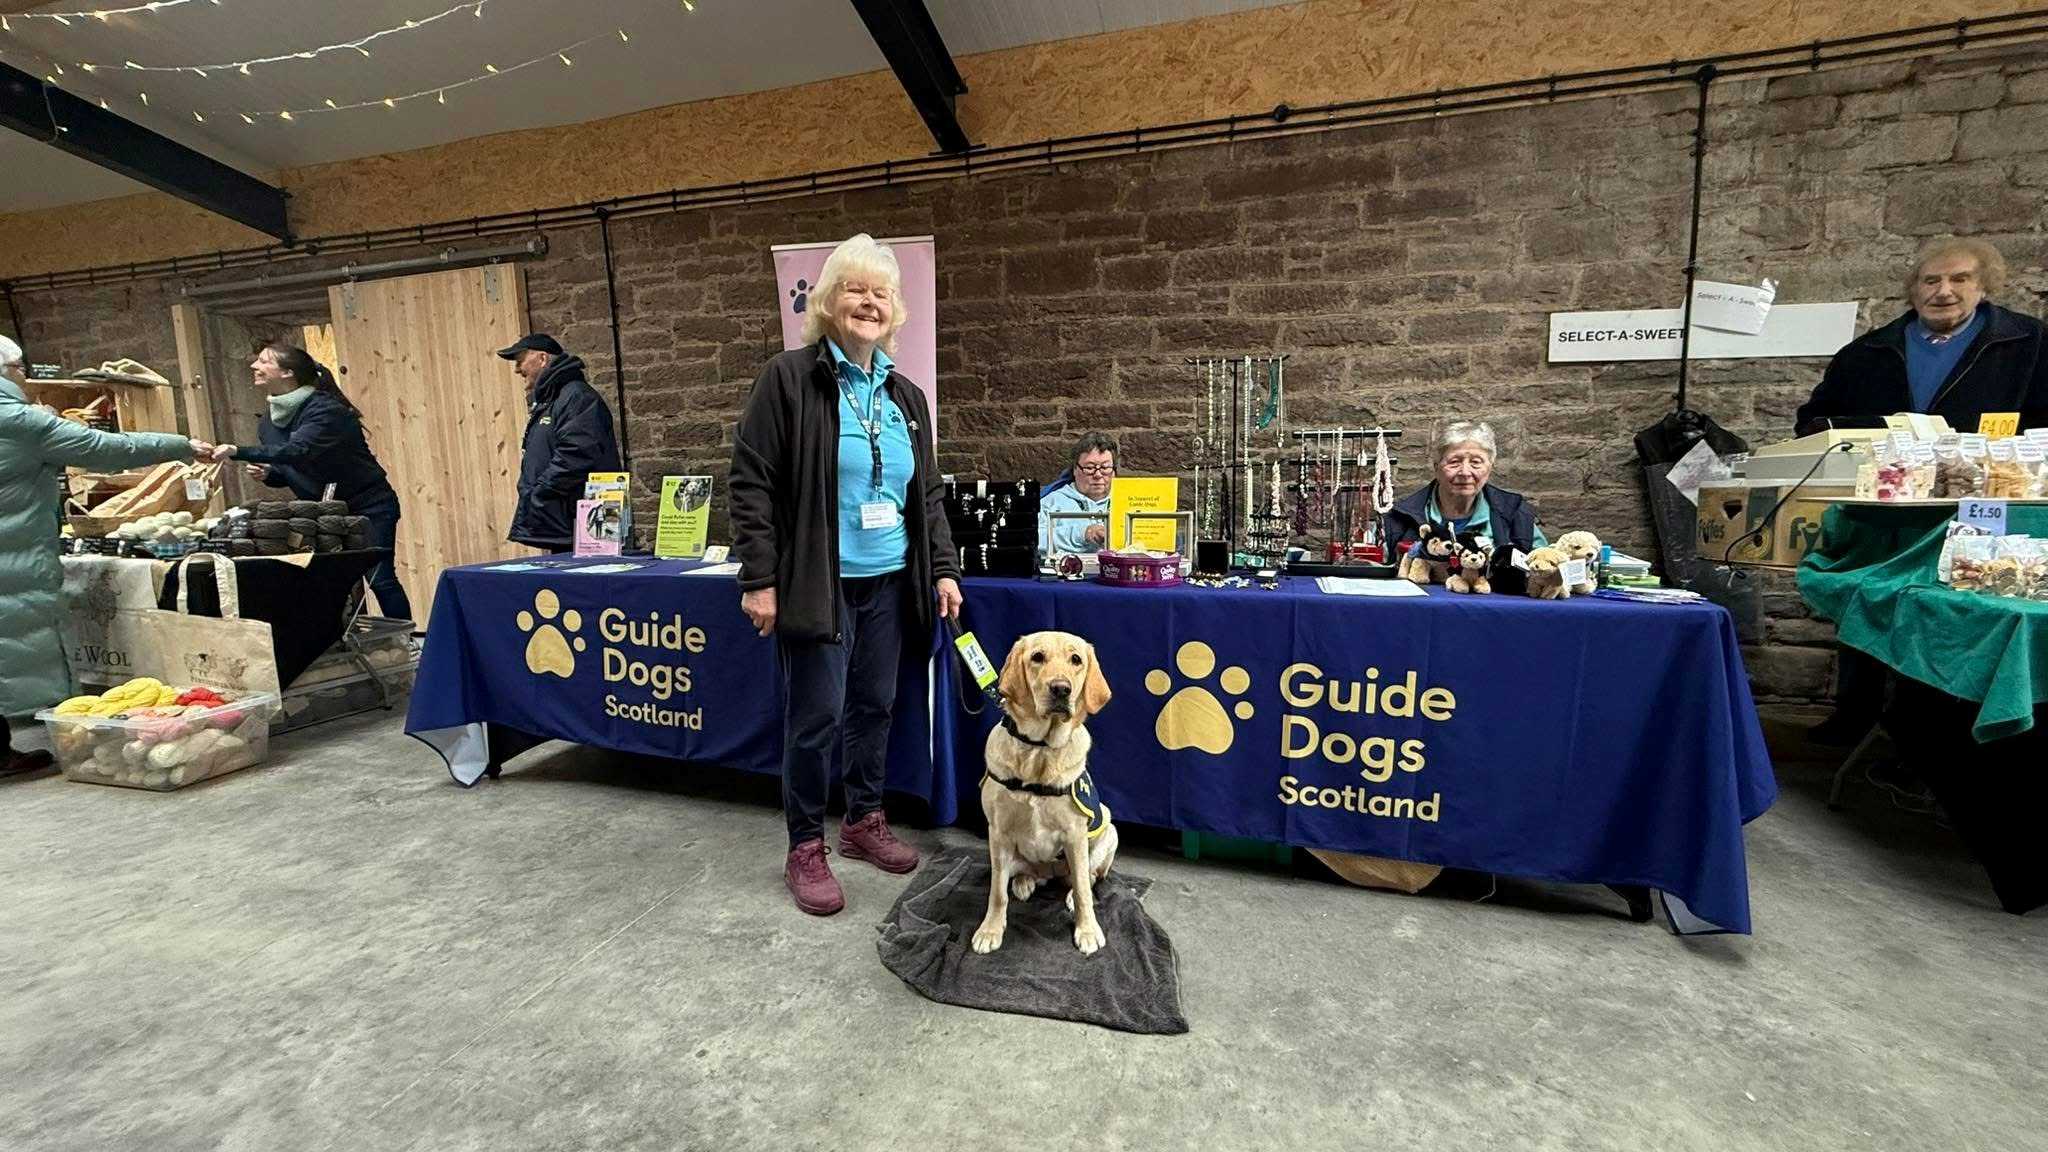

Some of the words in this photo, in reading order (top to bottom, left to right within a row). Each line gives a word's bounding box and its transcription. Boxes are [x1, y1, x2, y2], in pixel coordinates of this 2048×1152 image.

[1558, 328, 1685, 343] SELECT-A-SWEET
[1969, 503, 2001, 518] £1.50
[599, 607, 706, 653] Guide
[603, 647, 692, 700] Dogs
[1279, 662, 1456, 721] Guide
[604, 694, 703, 731] Scotland
[1280, 714, 1426, 783] Dogs
[1277, 775, 1441, 822] Scotland
